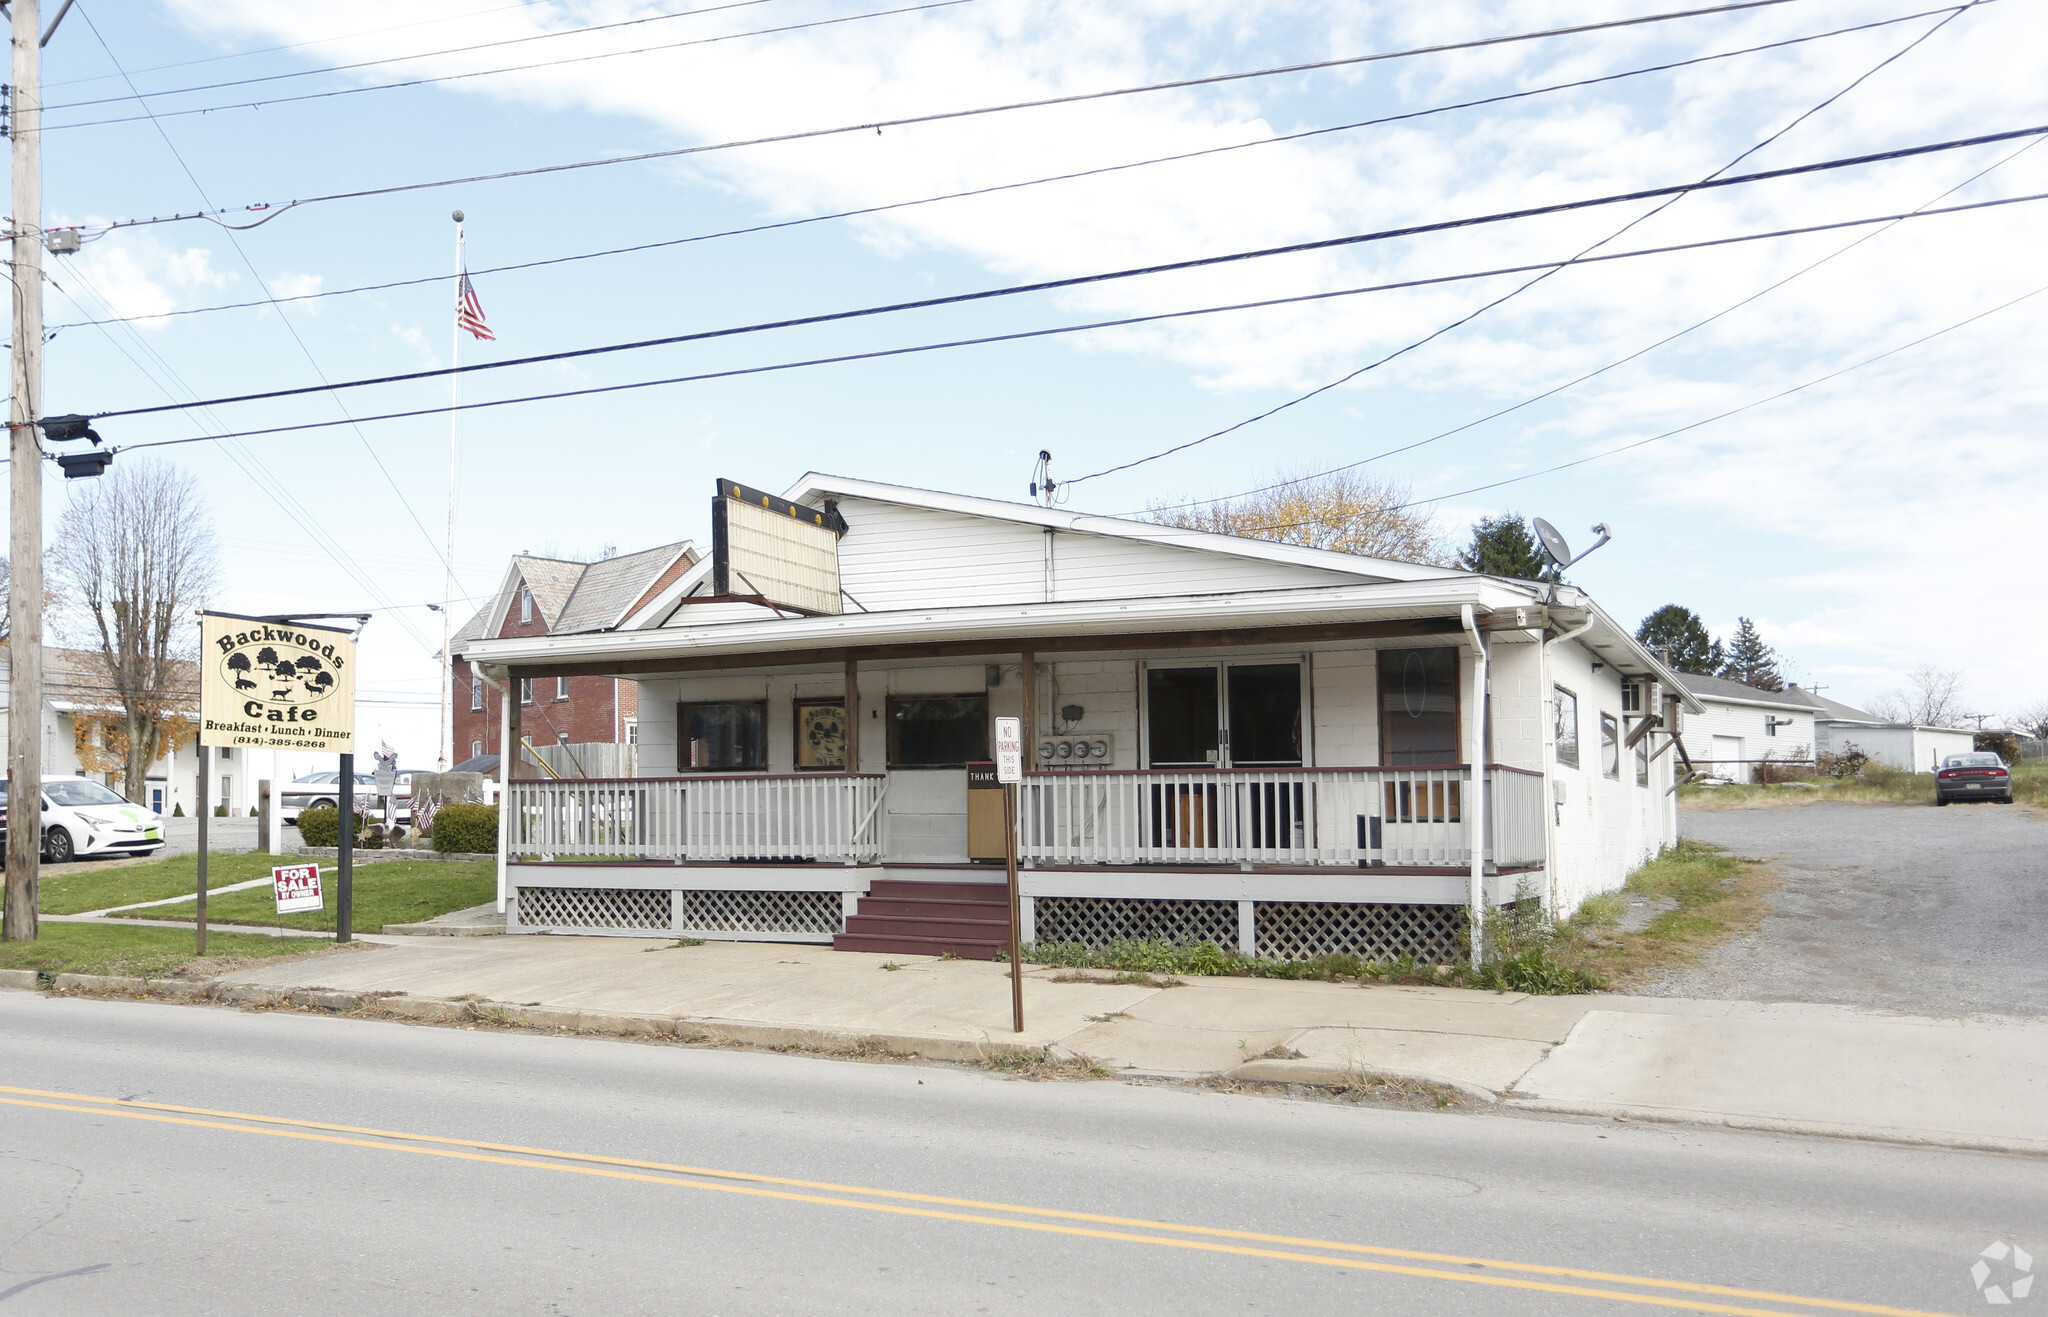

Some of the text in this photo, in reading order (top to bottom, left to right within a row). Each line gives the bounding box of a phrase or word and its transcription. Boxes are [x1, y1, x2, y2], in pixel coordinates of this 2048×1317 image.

[216, 626, 344, 669] Backwoods
[244, 701, 318, 722] Cafe
[205, 720, 351, 739] Breakfast Lunch Dinner
[1003, 726, 1012, 738] NO
[233, 736, 326, 749] (814)-385-6268
[998, 741, 1019, 752] PARKING
[1003, 766, 1015, 774] SIDE
[970, 772, 994, 781] THANK
[281, 869, 310, 880] FOR
[278, 878, 317, 892] SALE
[291, 890, 314, 898] OWNER
